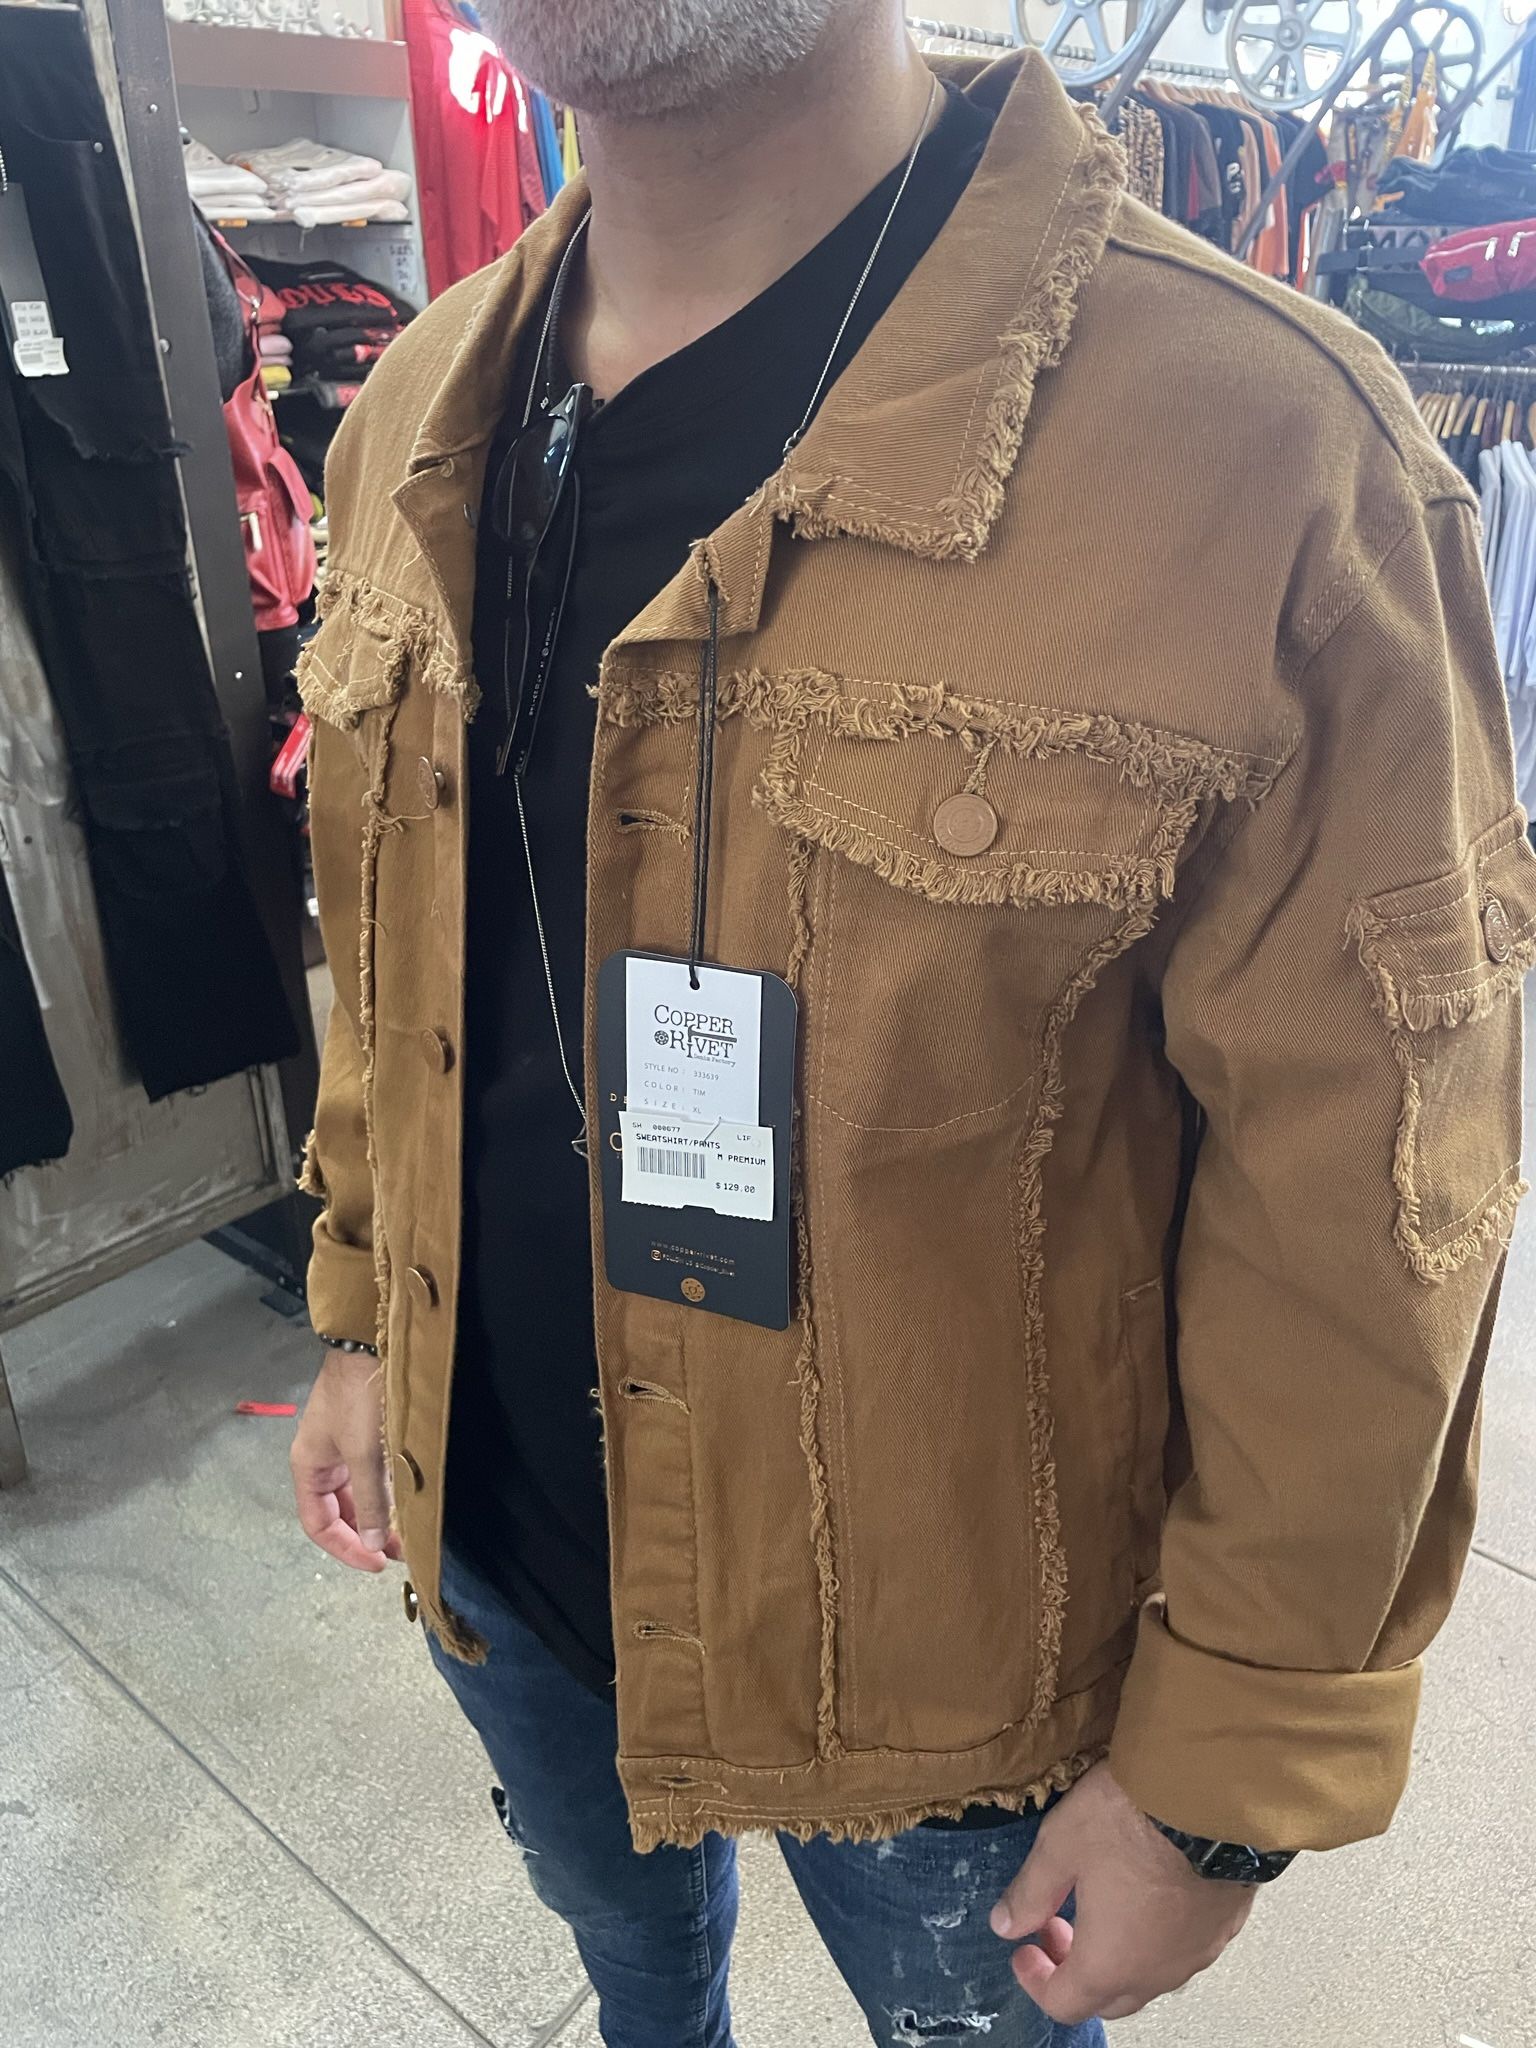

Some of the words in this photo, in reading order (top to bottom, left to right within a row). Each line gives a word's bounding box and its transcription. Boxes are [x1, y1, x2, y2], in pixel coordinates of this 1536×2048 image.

[654, 1004, 734, 1035] COPPER
[670, 1029, 734, 1059] RIVET
[644, 1062, 665, 1072] STYLE
[693, 1088, 706, 1097] TIM
[692, 1106, 702, 1114] XL
[635, 1132, 721, 1150] SWEATSHIRT/PANTS
[717, 1153, 723, 1161] M
[728, 1154, 766, 1166] PREMIUM
